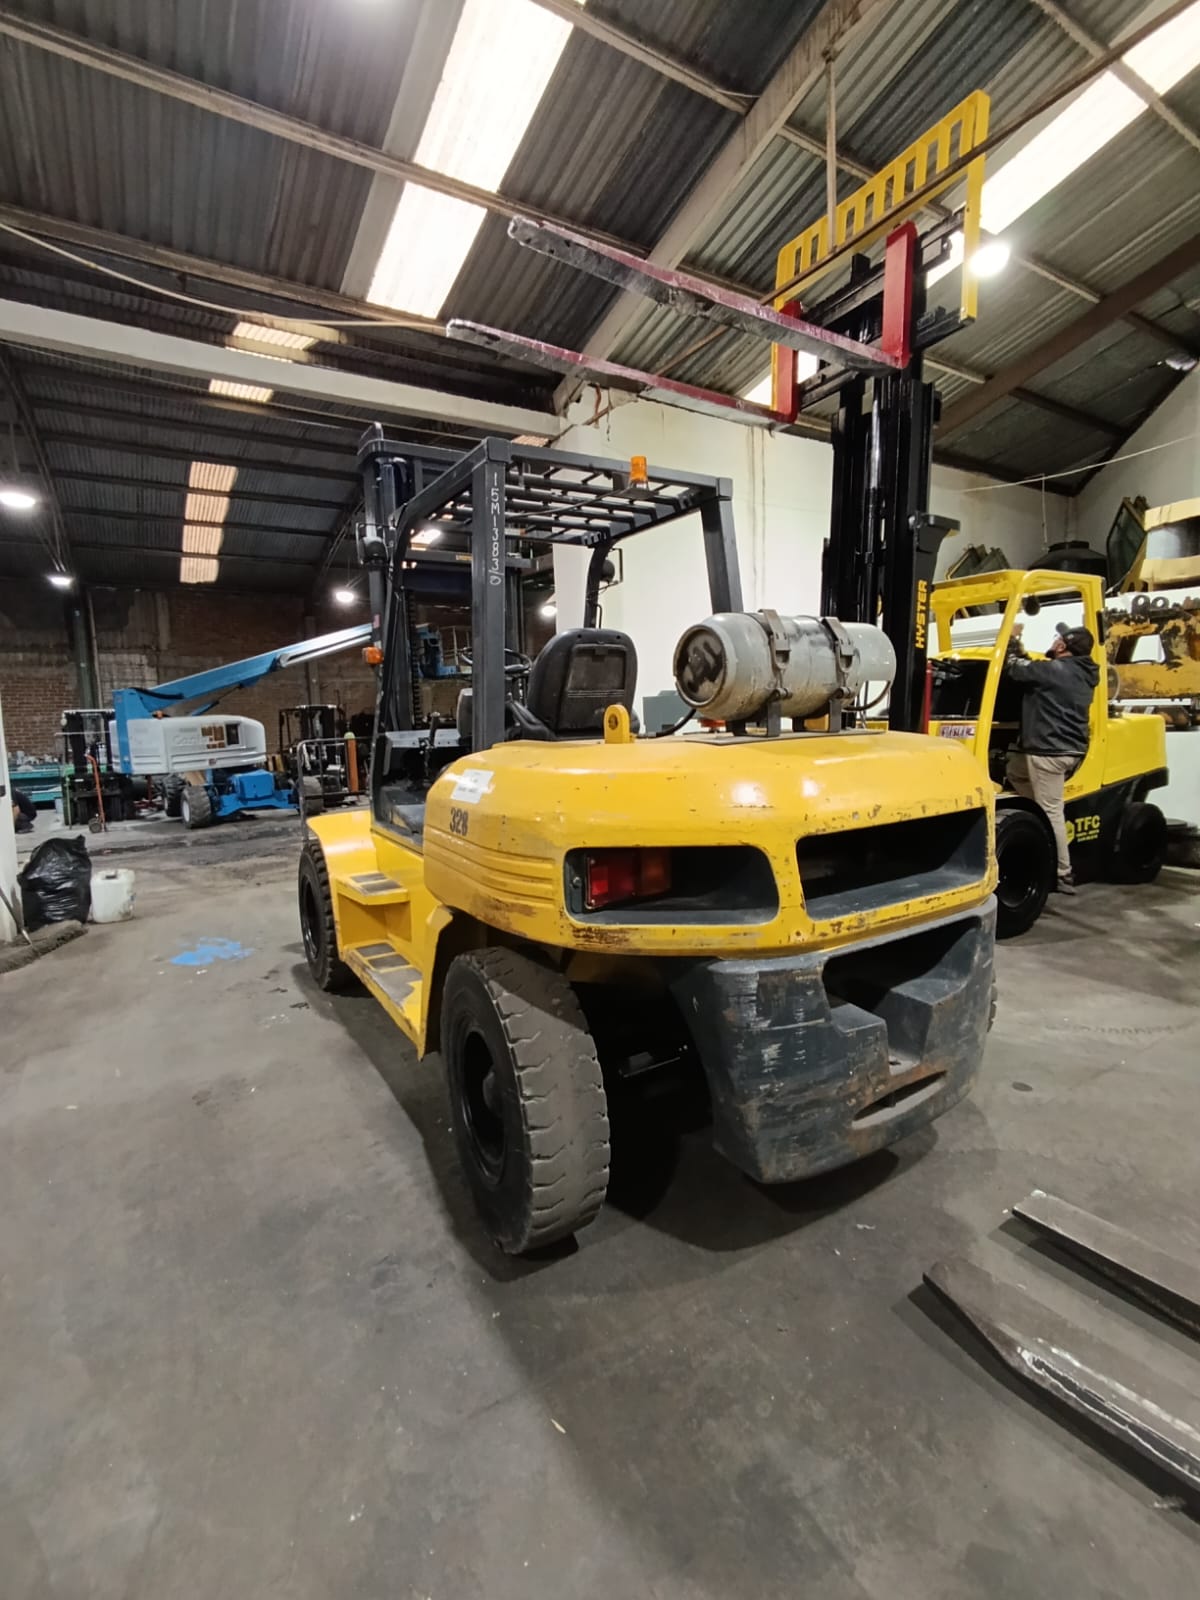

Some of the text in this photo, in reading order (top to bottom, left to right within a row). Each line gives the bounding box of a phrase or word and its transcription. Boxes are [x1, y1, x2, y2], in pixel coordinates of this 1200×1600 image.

[915, 579, 928, 649] HYSTER
[449, 806, 469, 837] 328
[1074, 814, 1101, 832] TFC
